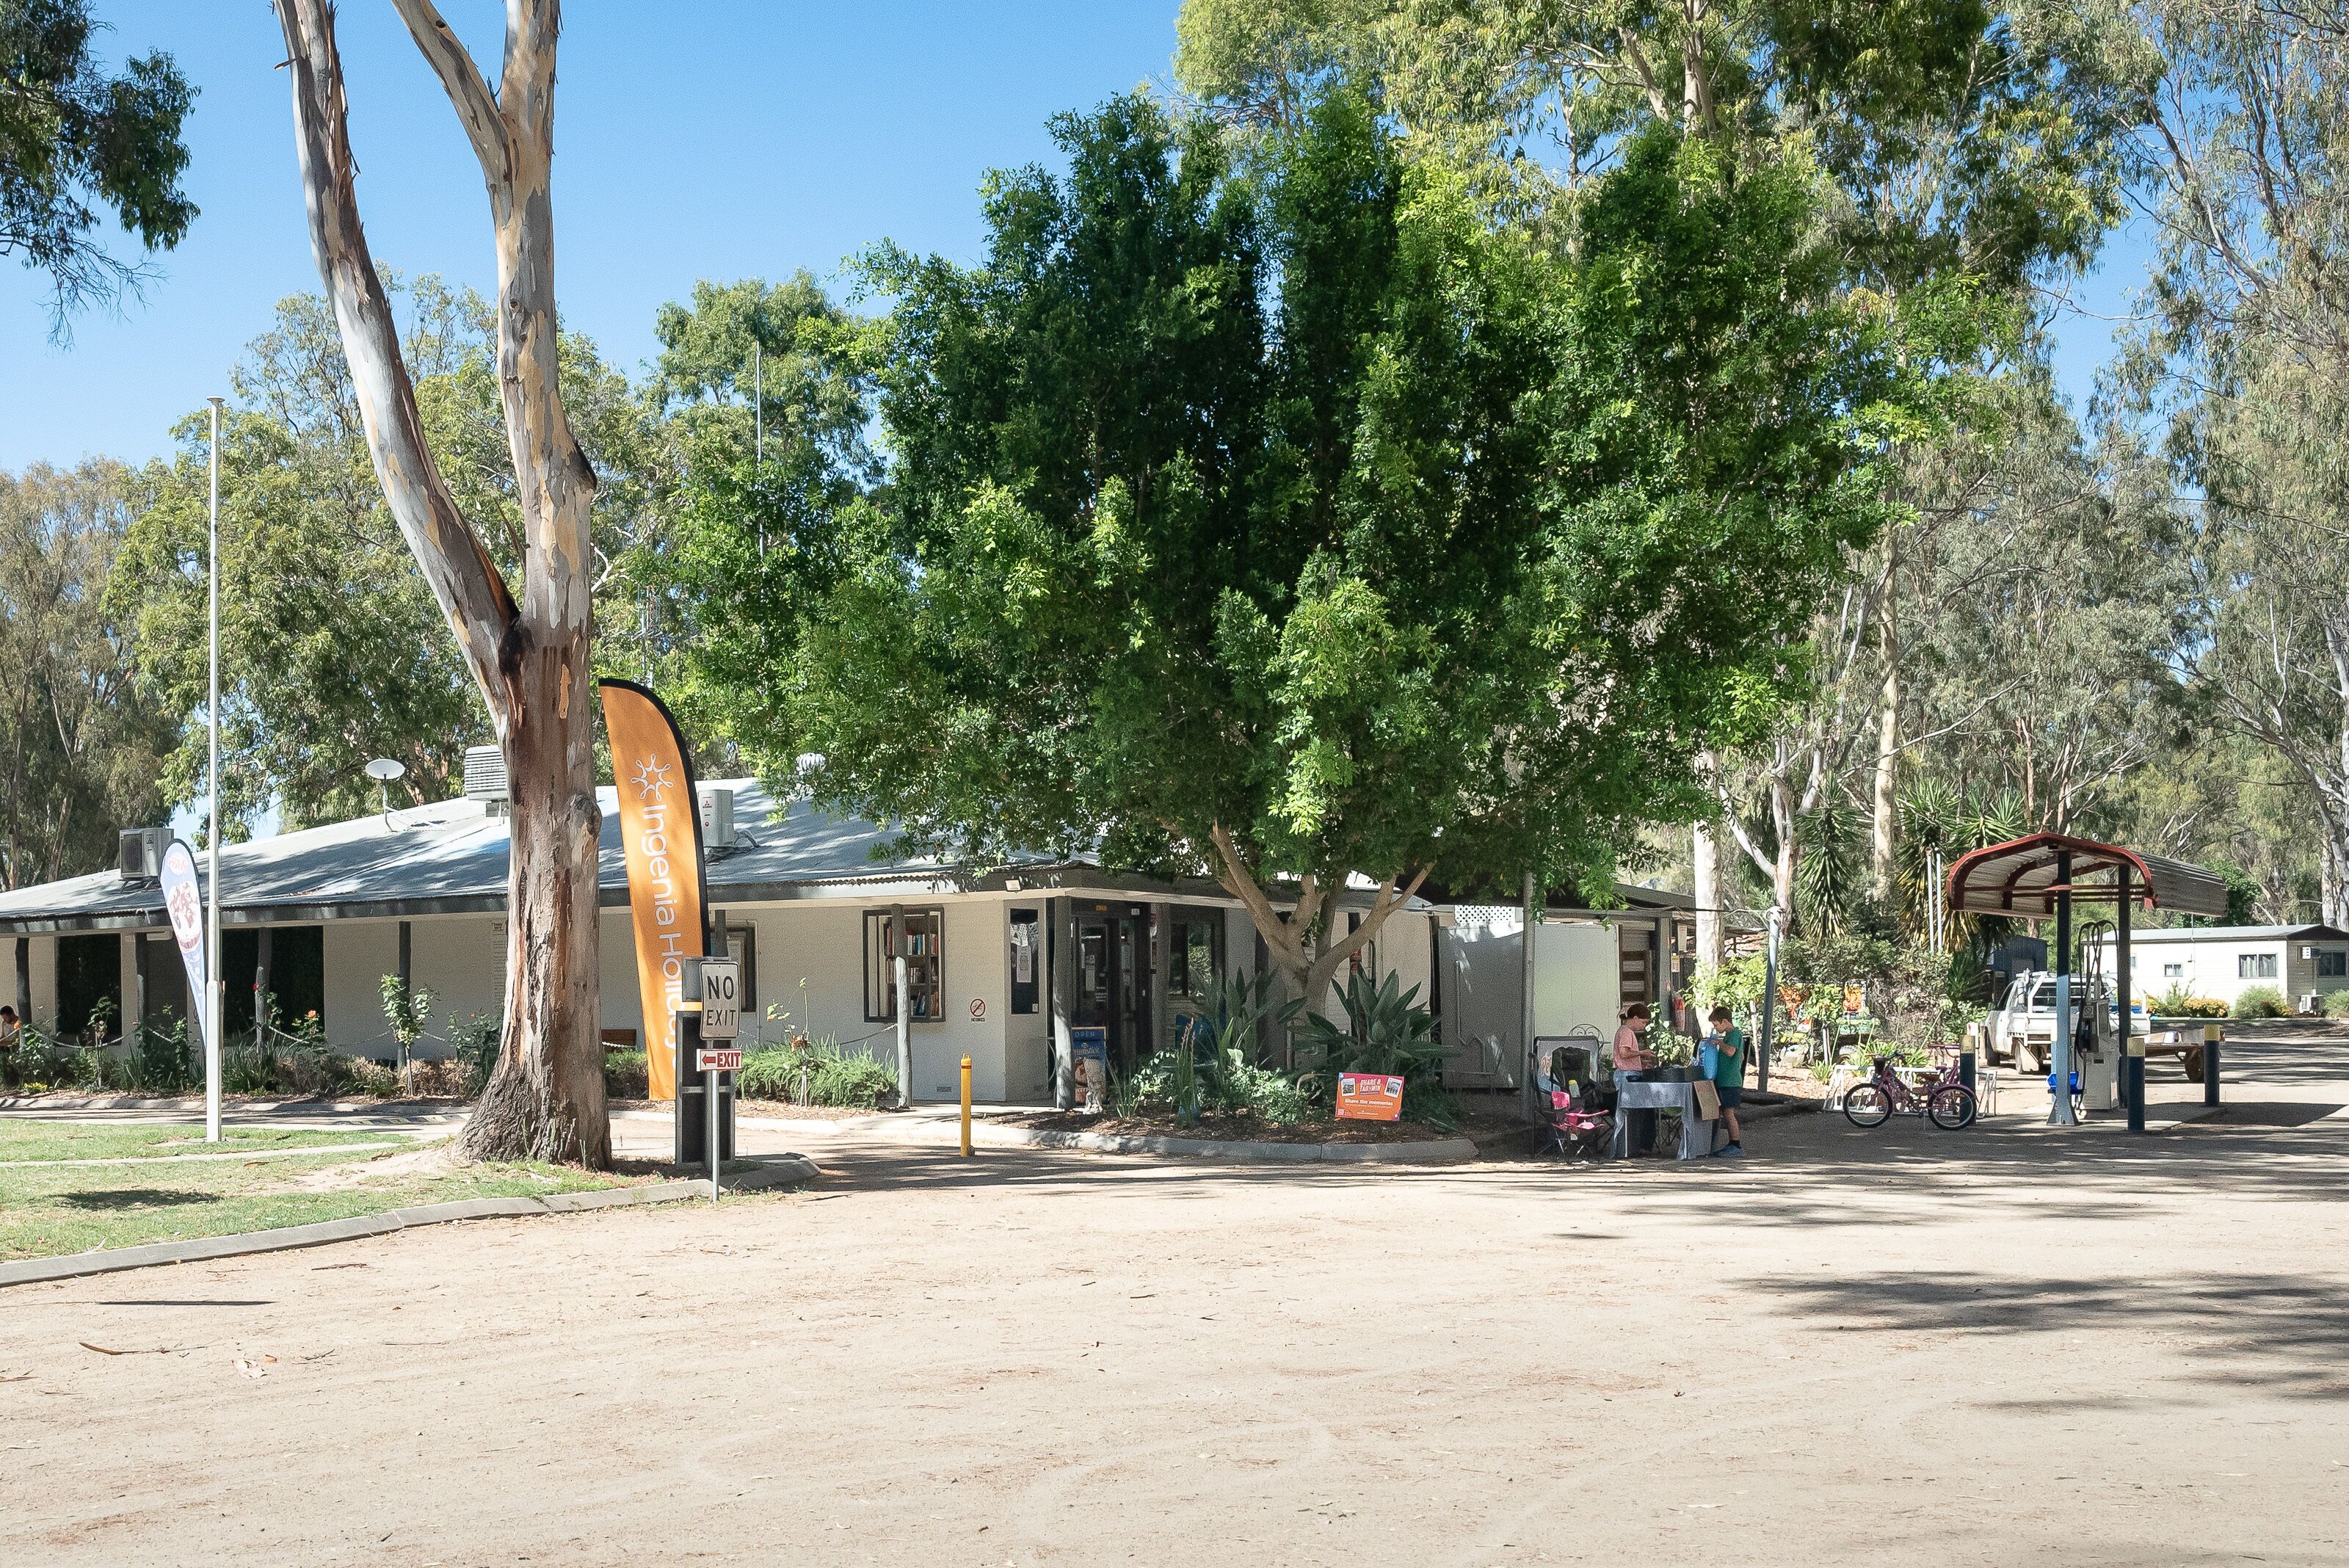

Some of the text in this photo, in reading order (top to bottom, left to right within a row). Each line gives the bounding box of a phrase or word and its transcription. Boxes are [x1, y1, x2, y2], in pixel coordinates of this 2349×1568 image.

[641, 804, 685, 1070] Ingenia Holiday
[707, 975, 734, 1001] NO
[706, 1009, 736, 1026] EXIT
[716, 1052, 741, 1067] EXIT
